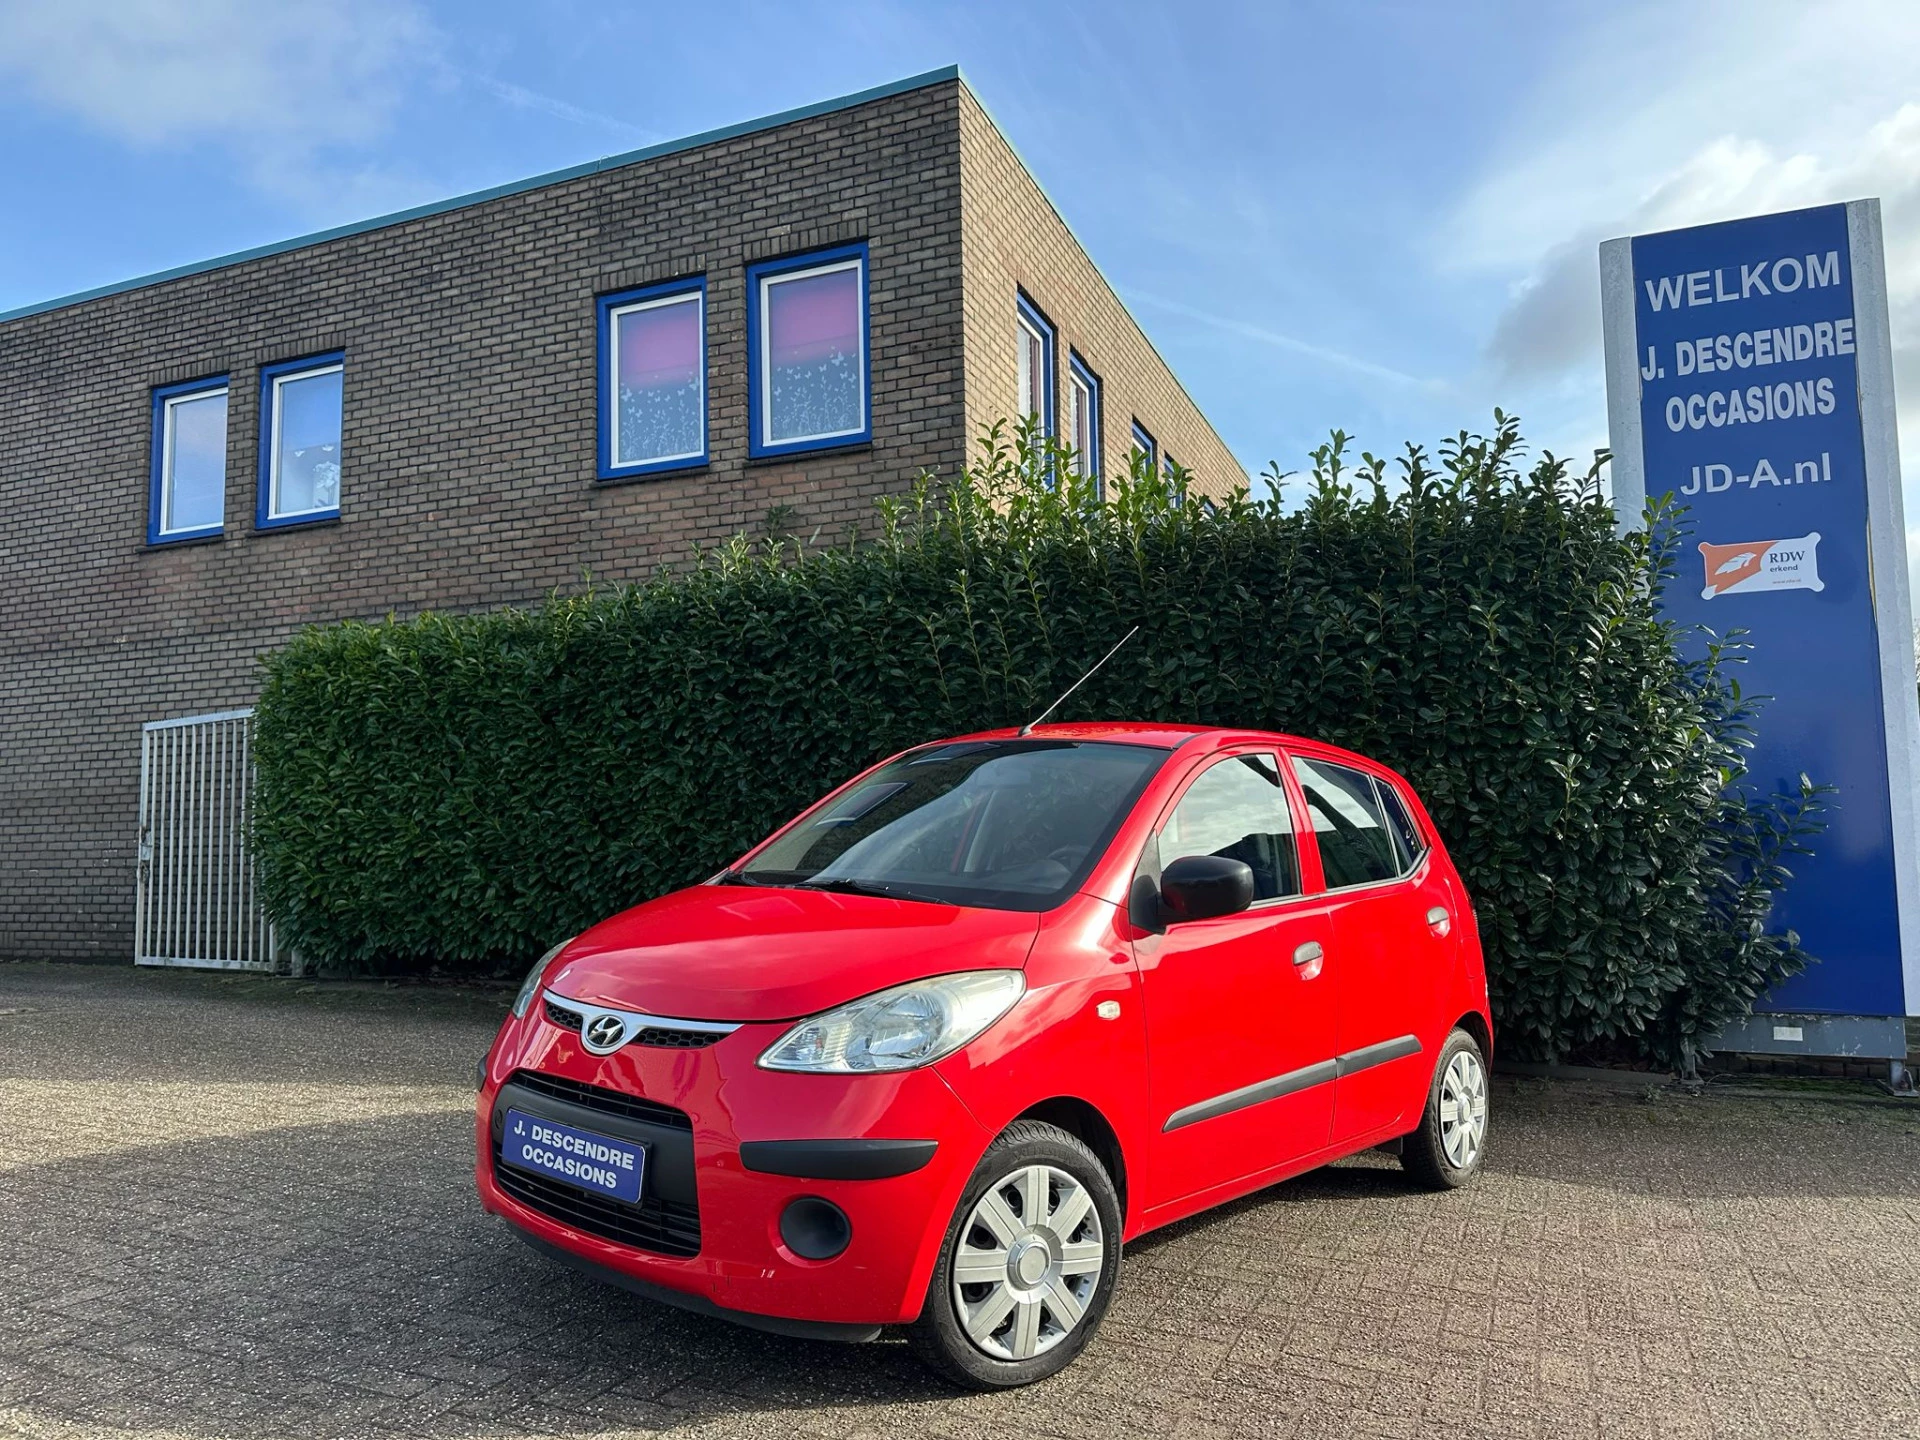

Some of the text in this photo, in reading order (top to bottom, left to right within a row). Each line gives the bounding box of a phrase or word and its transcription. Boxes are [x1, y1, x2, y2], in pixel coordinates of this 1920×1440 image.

[1644, 251, 1841, 312] WELKOM
[1641, 318, 1856, 381] J. DESCENDRE
[1665, 377, 1836, 432] OCCASIONS
[1680, 453, 1832, 496] JD-A.nl
[1769, 551, 1805, 563] RDW
[1769, 564, 1798, 573] erkend
[514, 1120, 635, 1171] J. DESCENDRE
[522, 1144, 617, 1189] OCCASIONS
